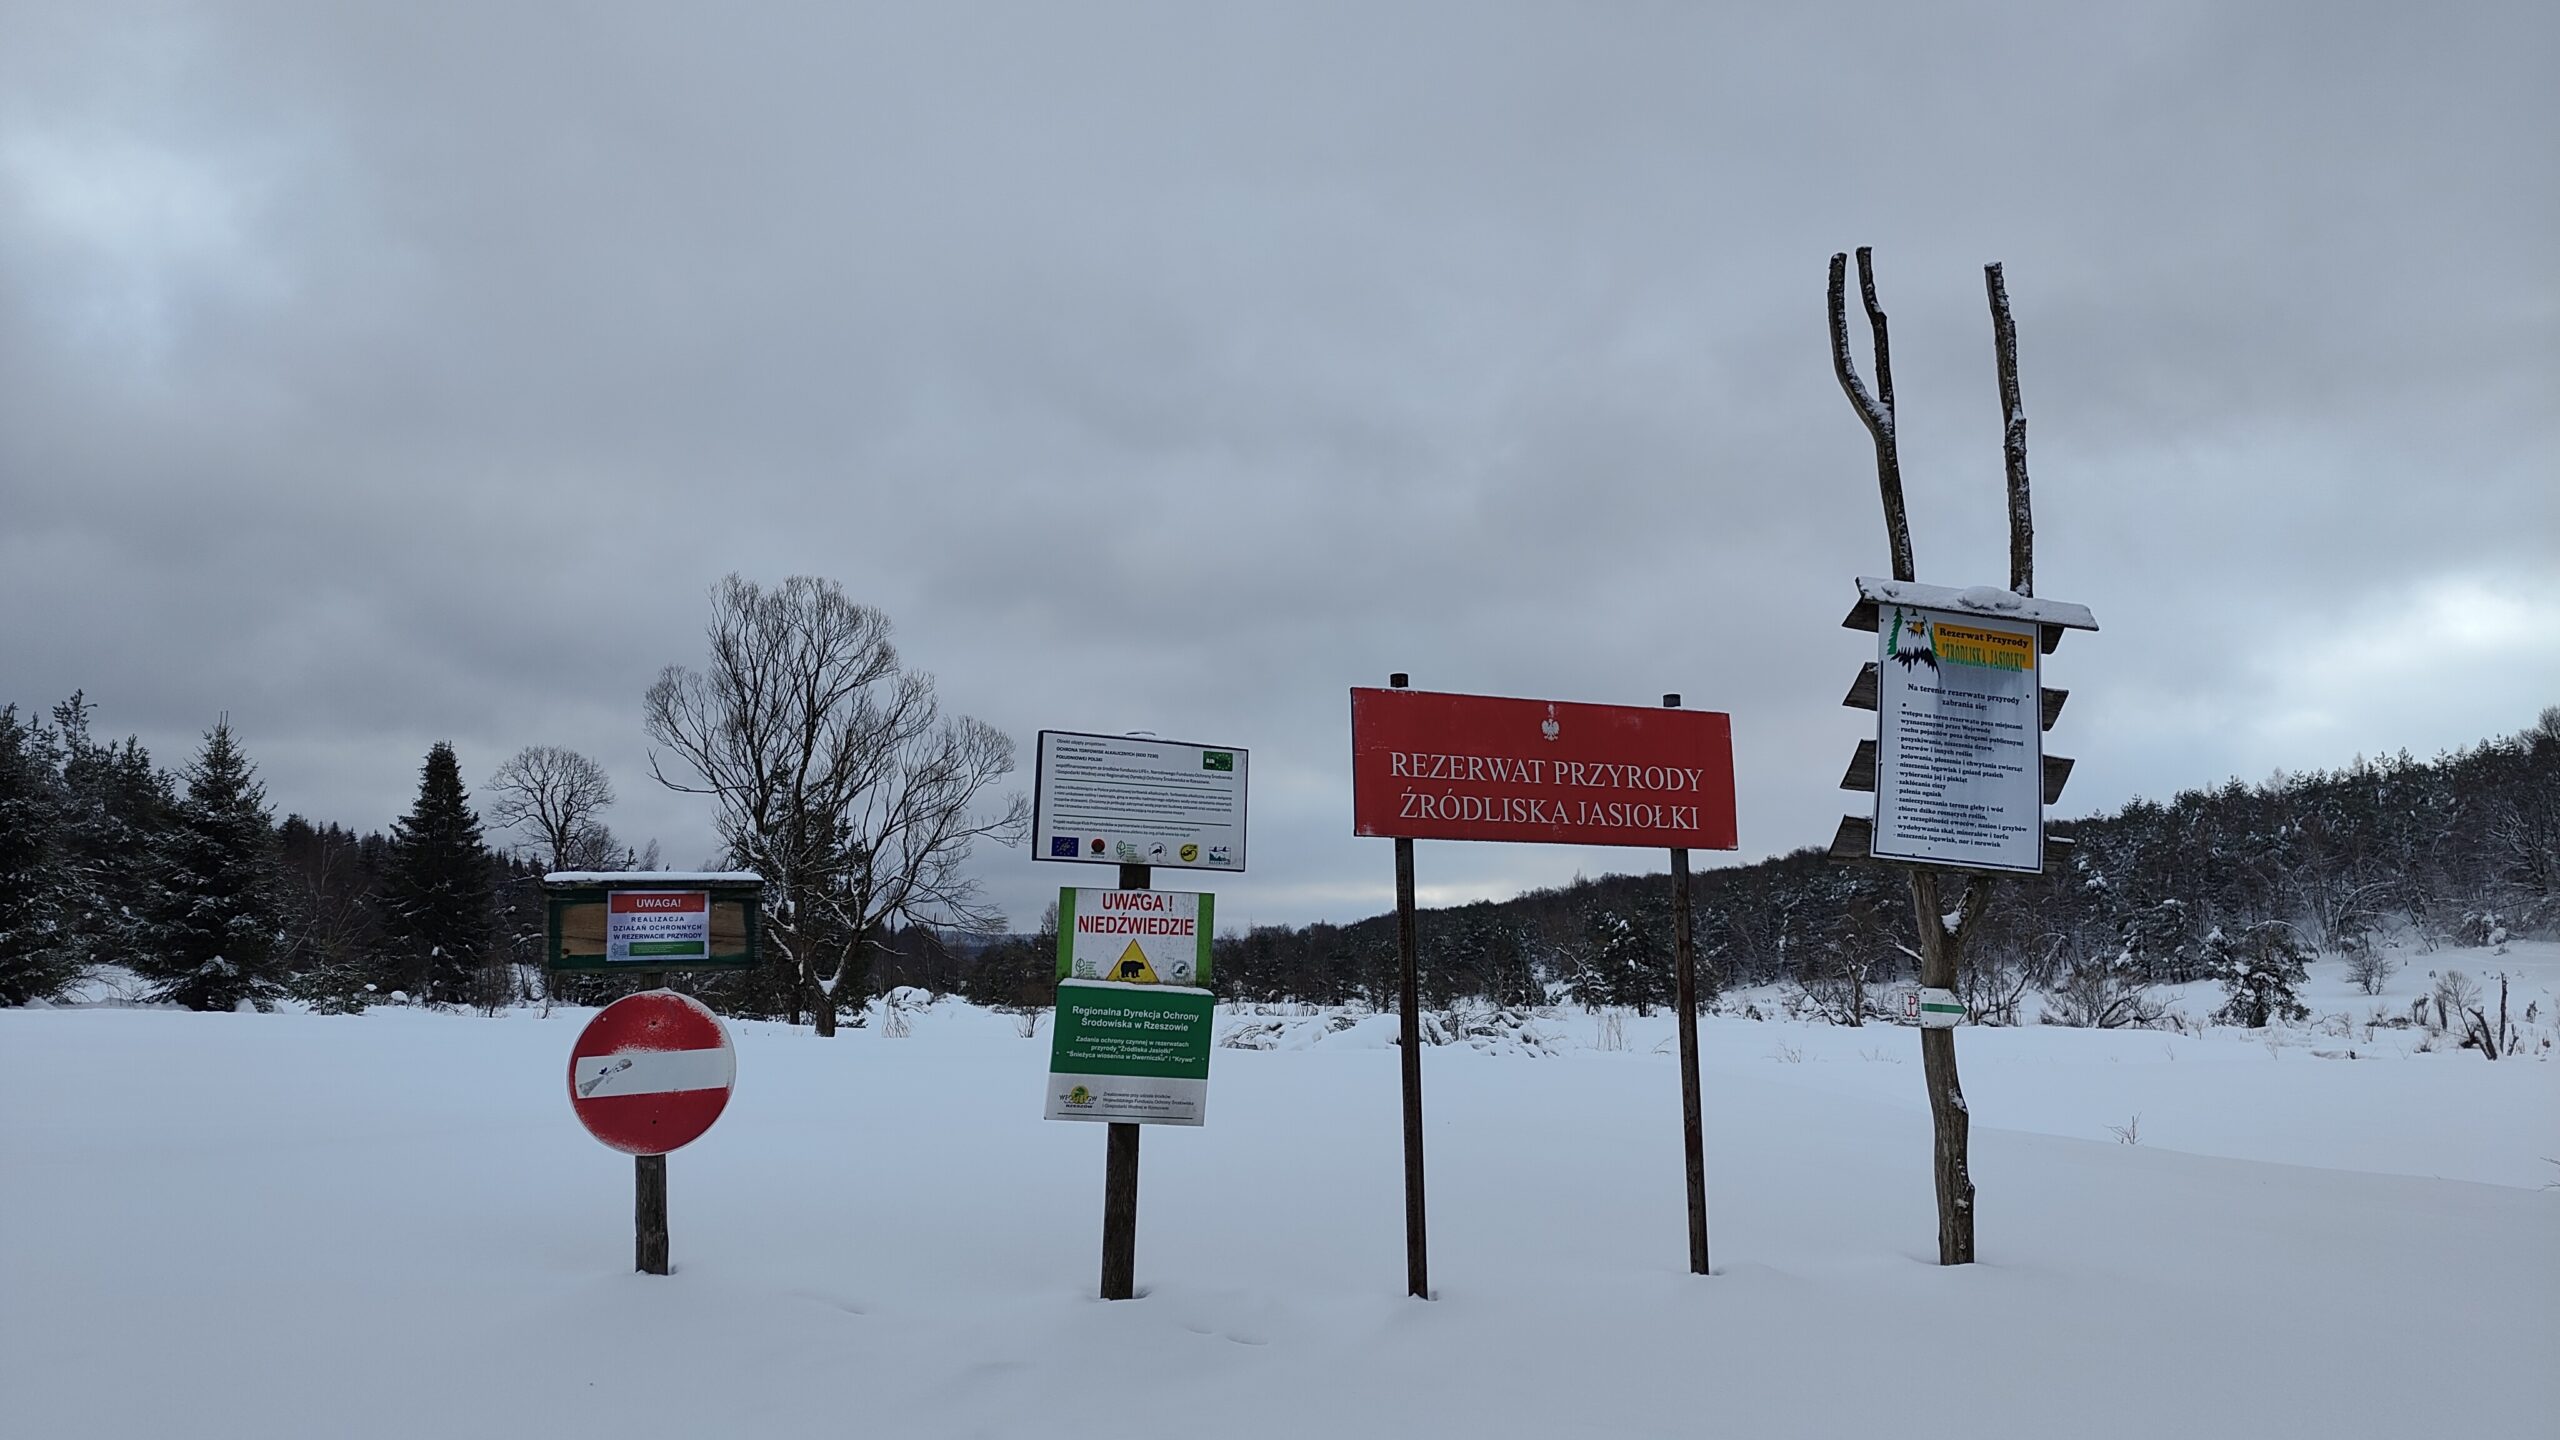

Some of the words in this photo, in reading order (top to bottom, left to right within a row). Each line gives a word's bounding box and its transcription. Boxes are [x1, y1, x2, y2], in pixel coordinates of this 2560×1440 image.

[1940, 628, 1984, 641] Rezerwat
[1986, 634, 2028, 648] Przyrody
[1908, 683, 1918, 692] Na
[1920, 686, 1946, 694] terenie
[1948, 690, 1985, 700] rezerwatu
[1987, 694, 2020, 705] przyrody
[1942, 699, 1973, 709] zabrania
[1901, 719, 1944, 728] wyznaczonymi
[1950, 716, 1979, 724] rezerwatu
[1995, 722, 2022, 730] miejscami
[1920, 728, 1948, 737] pojazdów
[1990, 736, 2024, 746] publicznymi
[1934, 747, 1954, 755] innych
[1956, 750, 1972, 758] roślin
[1390, 752, 1546, 784] REZERWAT
[1554, 761, 1704, 792] PRZYRODY
[1900, 762, 1930, 770] niszczenia
[1962, 768, 1982, 776] gniazd
[1982, 770, 2004, 778] ptasich
[1966, 760, 1996, 769] chwytania
[1900, 771, 1932, 780] wybierania
[1400, 786, 1570, 825] ŹRÓDLISKA
[1577, 802, 1700, 830] JASIOŁKI
[1899, 797, 1948, 807] zanieczyszczania
[1970, 804, 1985, 812] gleby
[1910, 816, 1949, 825] szczególności
[1896, 832, 1928, 840] niszczenia
[1898, 824, 1940, 834] wydobywania
[636, 898, 681, 908] UWAGA!
[1102, 893, 1164, 911] UWAGA
[1078, 912, 1194, 936] NIEDŹWIEDZIE
[1072, 1006, 1121, 1017] Regionalna
[1124, 1008, 1160, 1020] Dyrekcja
[1162, 1011, 1200, 1023] Ochrony
[1082, 1016, 1132, 1029] Środowiska
[1144, 1021, 1188, 1032] Rzeszowie
